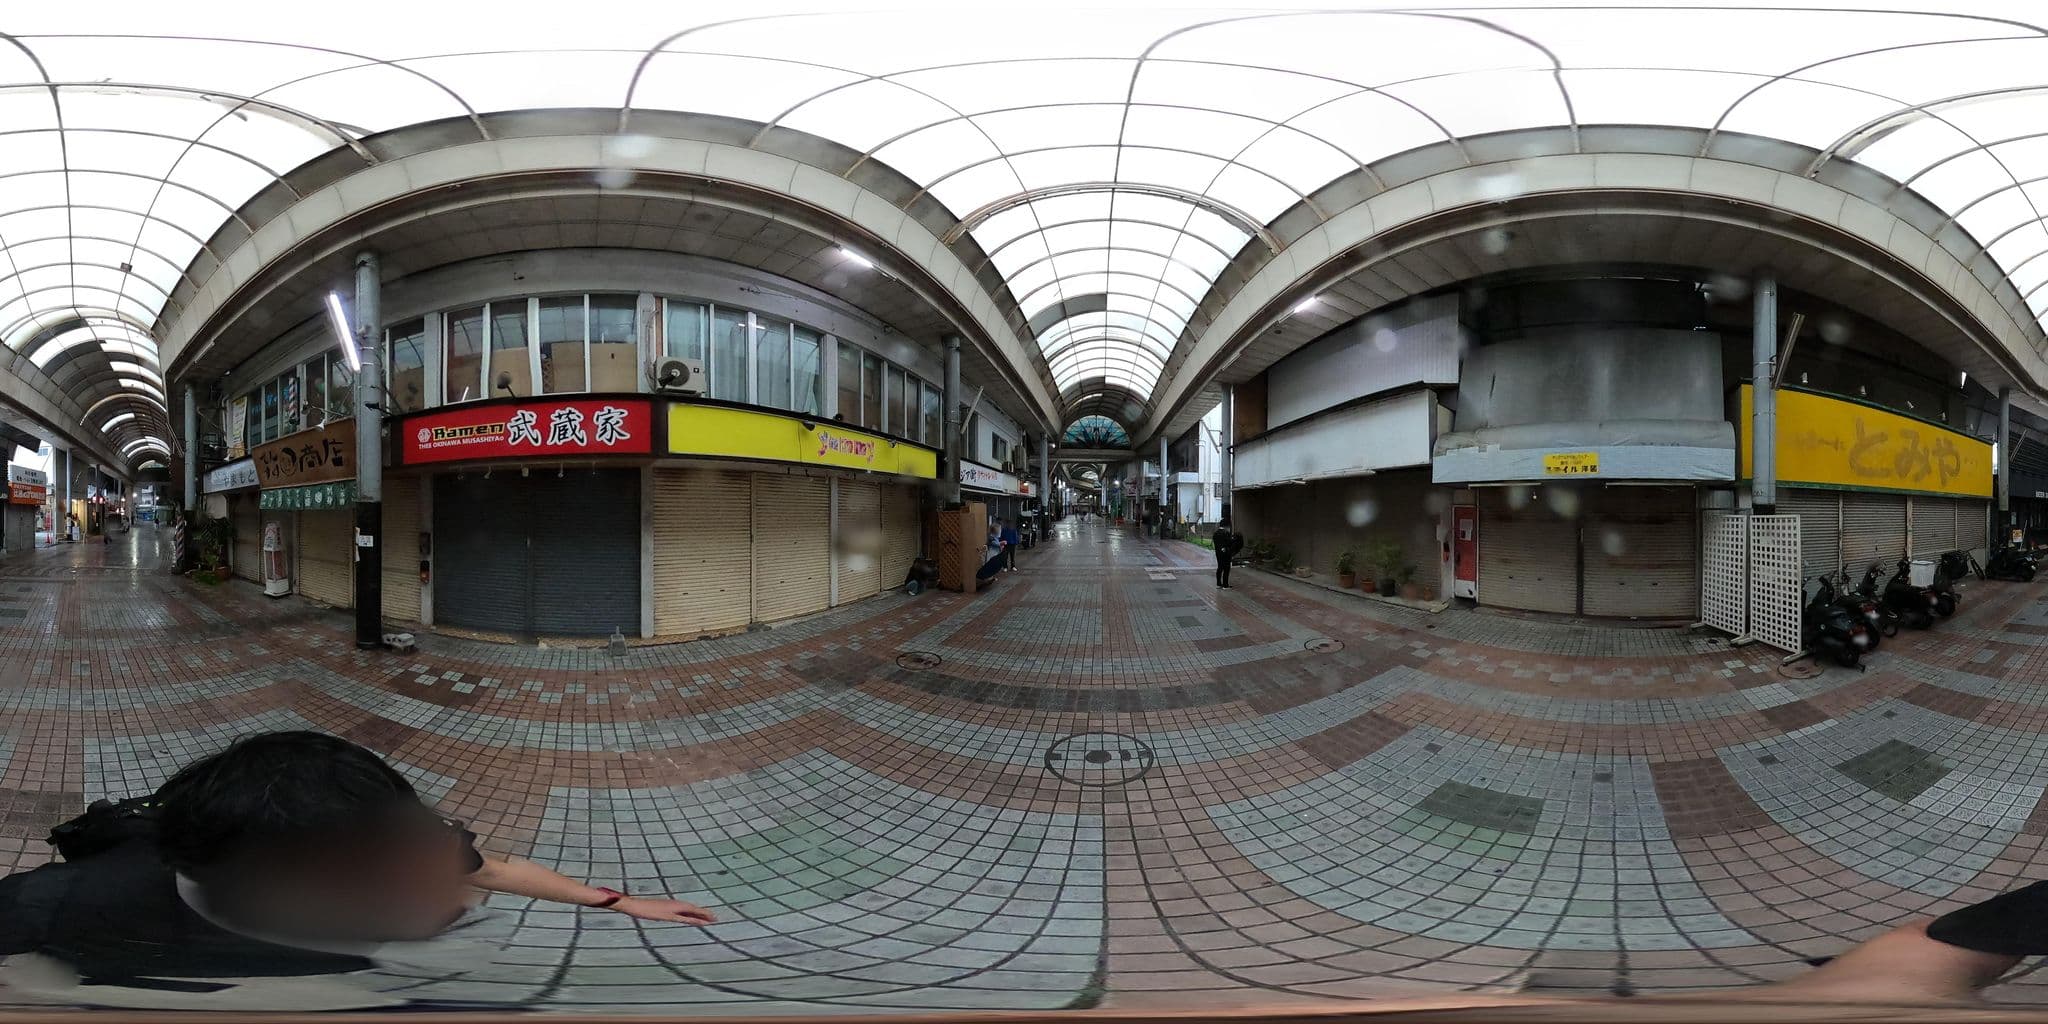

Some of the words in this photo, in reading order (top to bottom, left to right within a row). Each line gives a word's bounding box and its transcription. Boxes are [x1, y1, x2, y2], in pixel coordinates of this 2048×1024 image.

[432, 422, 505, 441] Ramen
[507, 405, 630, 446] 武蔵家
[432, 439, 462, 448] OKINAWA
